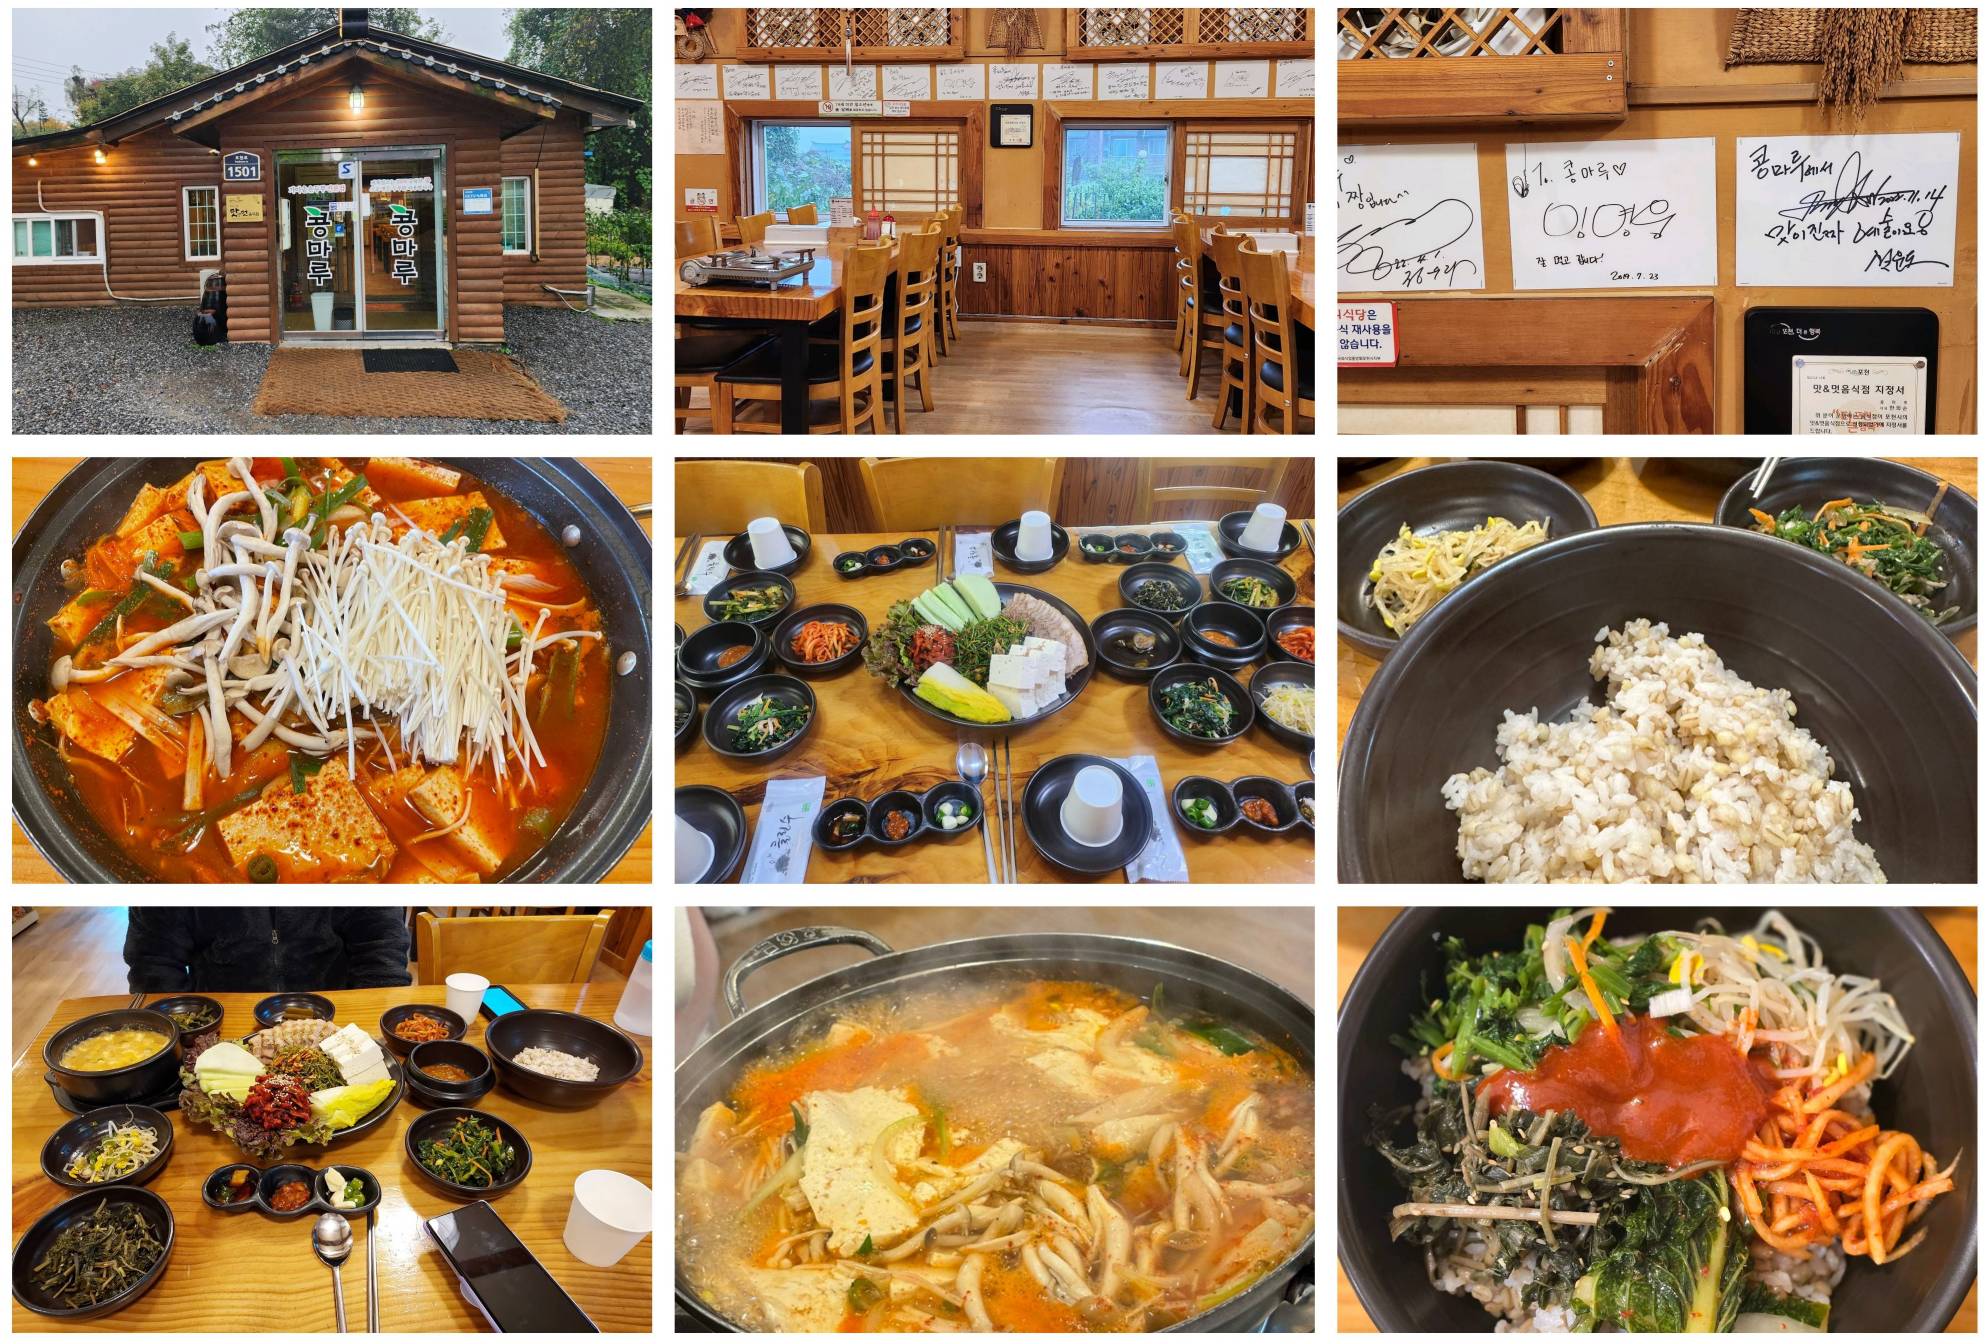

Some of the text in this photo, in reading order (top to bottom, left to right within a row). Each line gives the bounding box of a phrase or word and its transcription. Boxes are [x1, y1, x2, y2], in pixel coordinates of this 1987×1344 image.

[1749, 144, 1834, 183] 콩마루에서
[228, 166, 256, 177] 1501
[304, 206, 333, 286] 콩마루
[389, 204, 418, 285] 콩마루
[1351, 324, 1392, 335] 재사용을
[1339, 338, 1382, 350] 않습니다.
[1813, 384, 1905, 395] 맛&멋음식점 지정서
